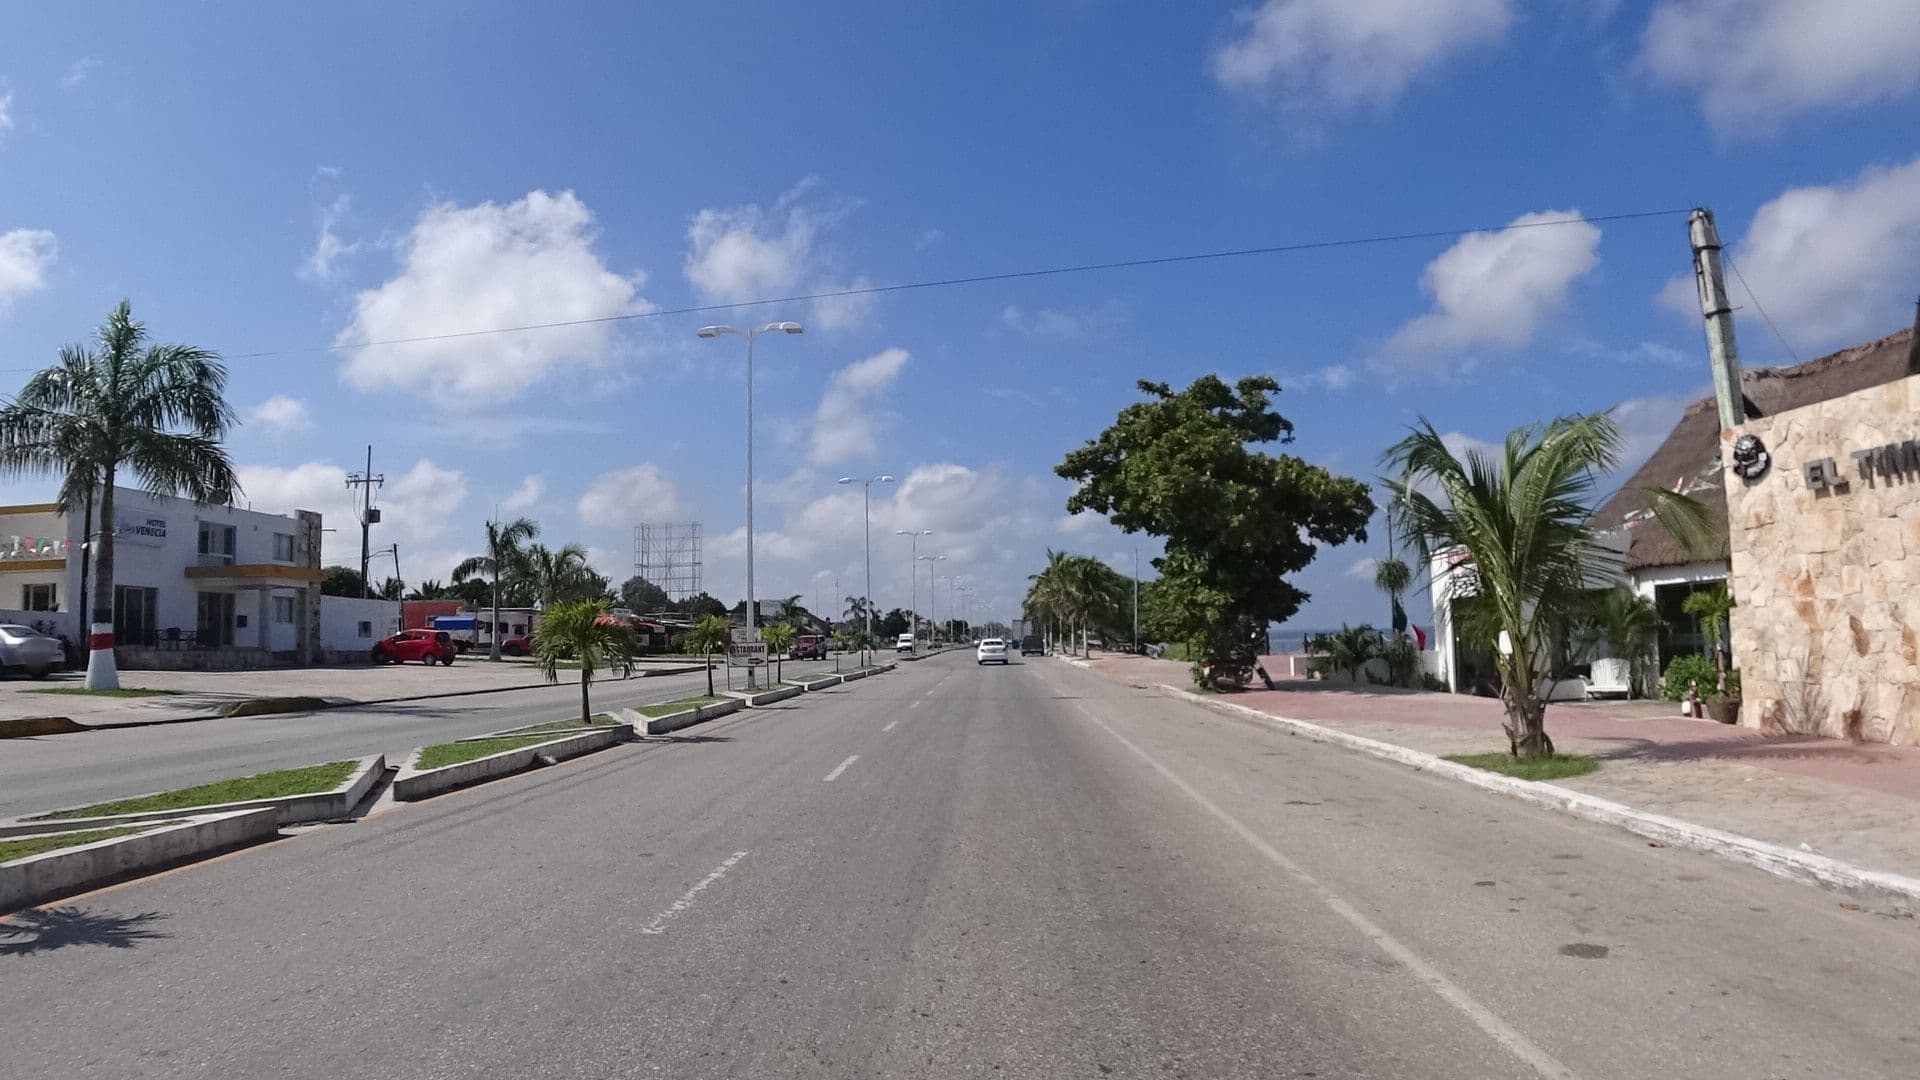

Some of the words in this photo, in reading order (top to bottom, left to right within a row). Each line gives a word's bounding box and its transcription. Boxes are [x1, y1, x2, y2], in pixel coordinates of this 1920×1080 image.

[1803, 457, 1849, 491] EL
[147, 519, 165, 528] HOTEL
[136, 526, 165, 537] VENECIA
